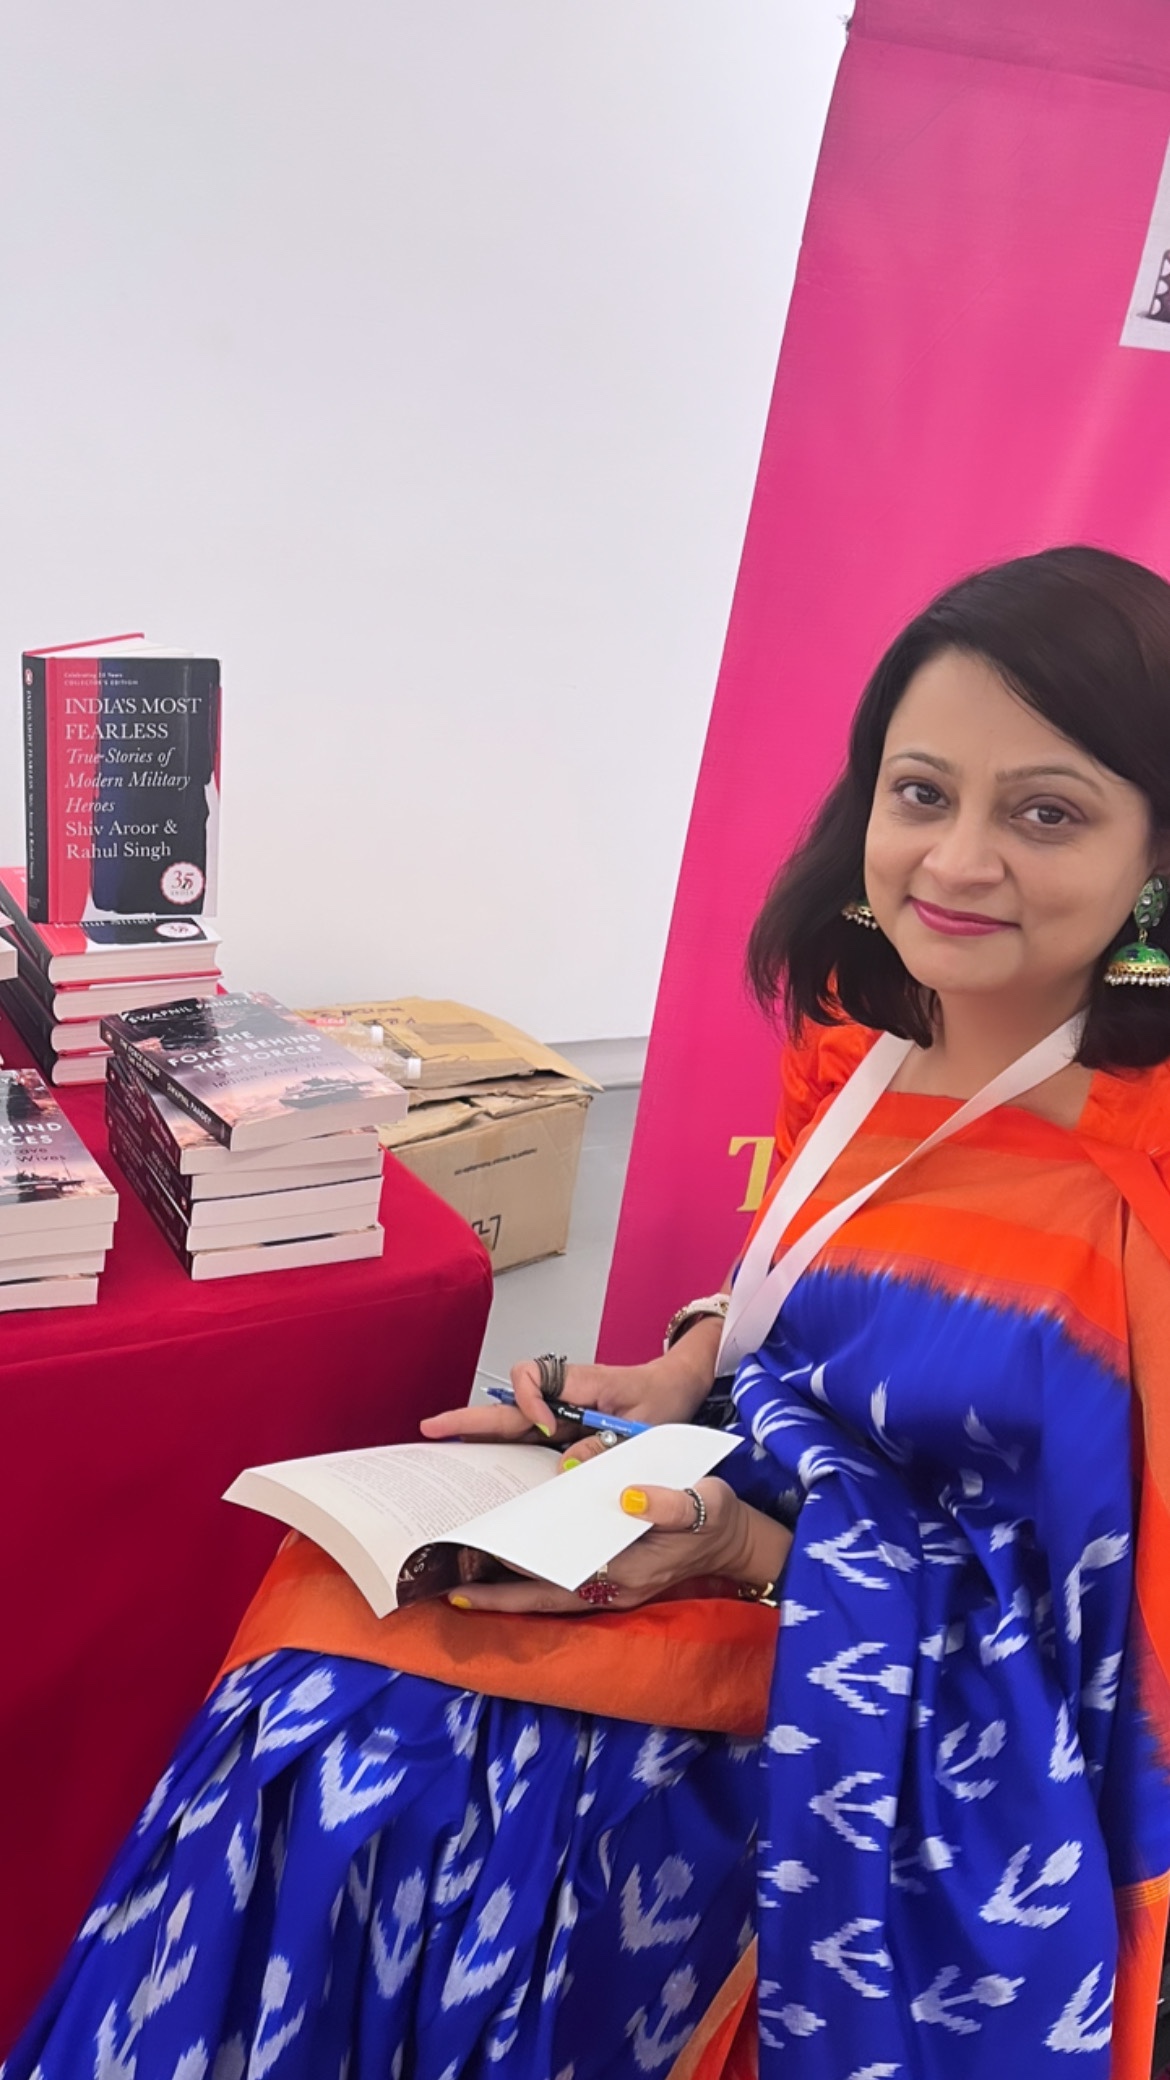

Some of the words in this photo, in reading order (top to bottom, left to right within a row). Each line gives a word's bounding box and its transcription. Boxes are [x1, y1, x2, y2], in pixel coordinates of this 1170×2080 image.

[65, 698, 137, 714] INDIA'S
[141, 698, 202, 714] MOST
[65, 723, 169, 740] FEARLESS
[157, 747, 176, 767] of
[65, 772, 123, 788] Modern
[128, 771, 191, 791] Military
[65, 797, 116, 813] Heroes
[65, 820, 104, 836] Shiv
[108, 820, 159, 836] Aroor
[163, 818, 178, 834] &
[66, 842, 118, 859] Rahul
[123, 841, 171, 861] Singh
[129, 1006, 193, 1024] SWAPNIL
[214, 1031, 254, 1043] THE
[167, 1045, 240, 1067] FORCE
[244, 1034, 321, 1050] BEHIND
[193, 1058, 236, 1073] THE
[241, 1044, 321, 1063] FORCES
